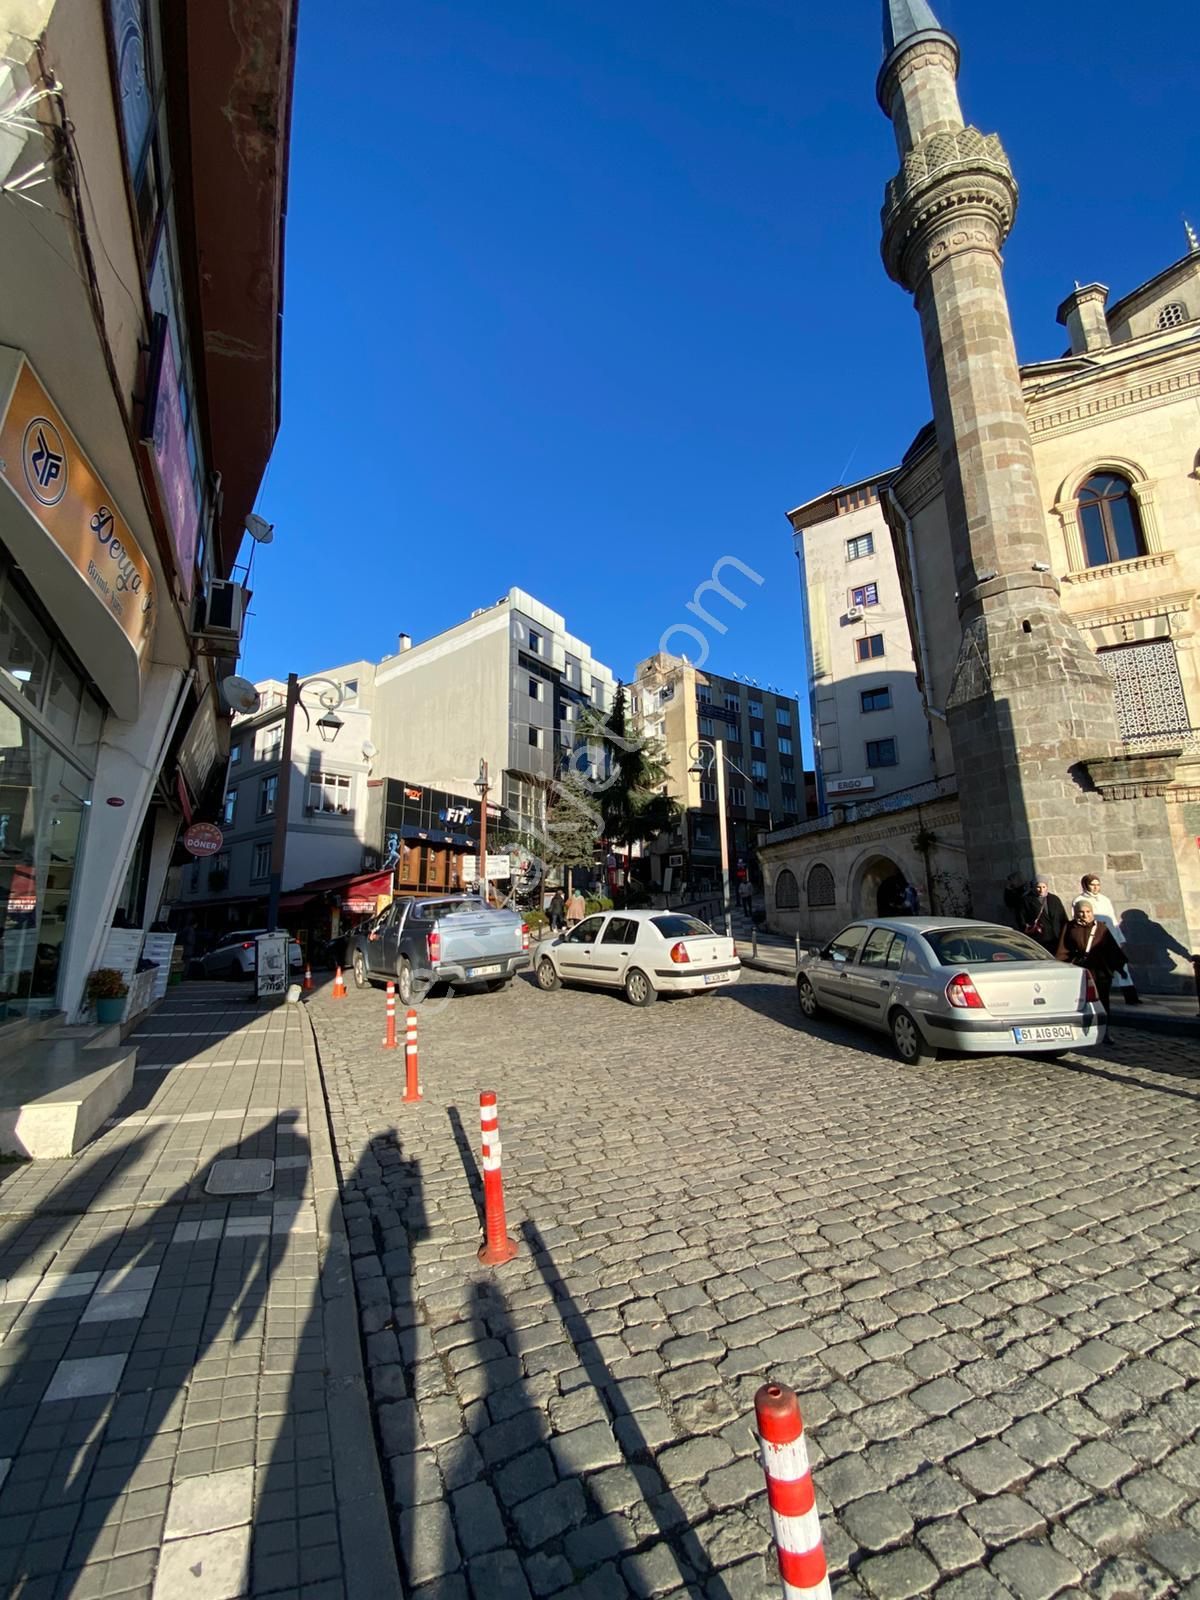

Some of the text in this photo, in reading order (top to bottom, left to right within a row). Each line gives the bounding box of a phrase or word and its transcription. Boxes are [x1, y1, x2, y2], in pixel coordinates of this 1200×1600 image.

[90, 505, 142, 595] Derya
[837, 780, 862, 790] ERGO
[1021, 1026, 1071, 1040] 61 AIG 804
